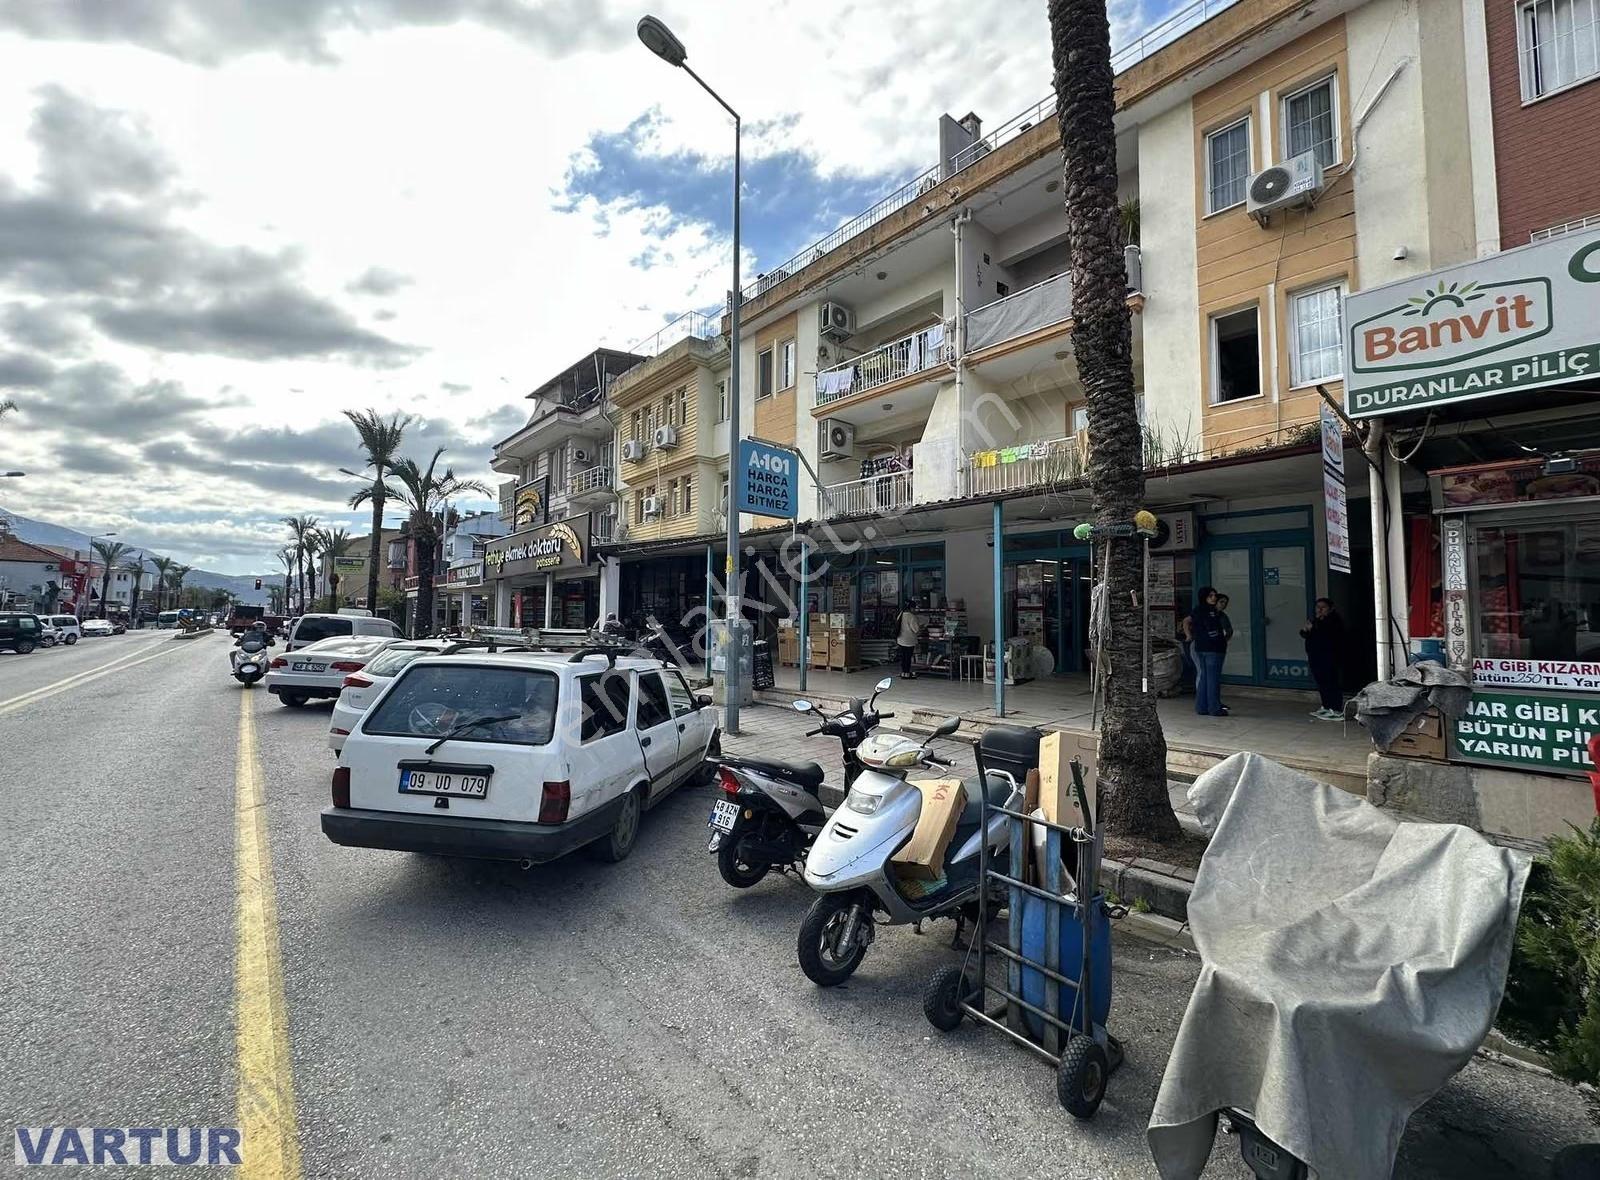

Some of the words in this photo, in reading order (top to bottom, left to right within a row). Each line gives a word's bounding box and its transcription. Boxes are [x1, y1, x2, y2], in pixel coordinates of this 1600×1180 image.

[1363, 294, 1534, 362] Banvit
[1356, 368, 1503, 409] DURANLAR
[1511, 351, 1590, 381] PİLİÇ
[748, 469, 789, 487] HARCA
[748, 482, 789, 499] HARCA
[505, 545, 527, 562] ekmek
[528, 538, 561, 558] doktoru
[1447, 530, 1462, 589] DURANLAR
[1515, 672, 1542, 684] 250
[1543, 676, 1567, 686] TL.
[1515, 702, 1569, 723] GİBİ
[1458, 720, 1547, 740] BÜTÜN
[1459, 738, 1543, 759] YARIM
[409, 773, 425, 789] 09
[435, 774, 451, 790] UD
[461, 777, 484, 793] 079
[716, 814, 731, 826] 916
